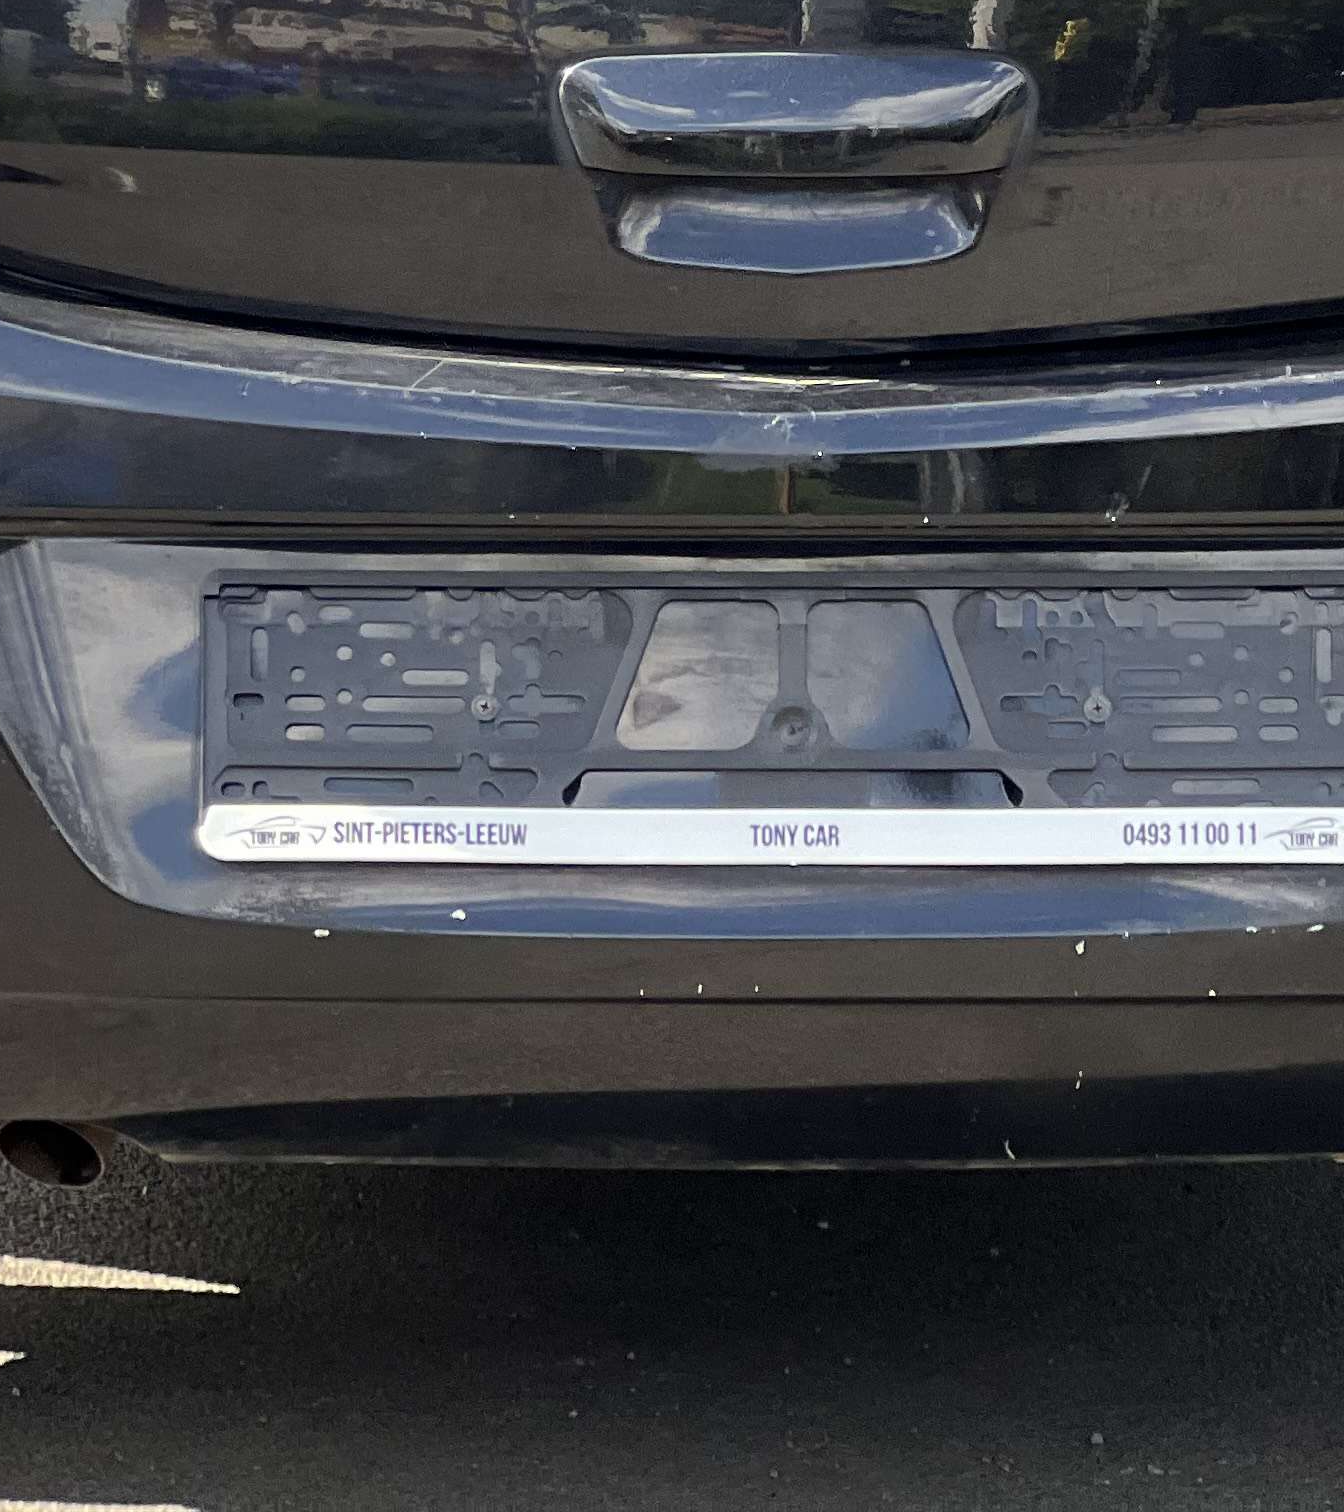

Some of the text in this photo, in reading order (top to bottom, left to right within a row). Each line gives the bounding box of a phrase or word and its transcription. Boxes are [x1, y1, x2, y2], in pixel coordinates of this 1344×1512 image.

[333, 821, 528, 846] SINT-PIETERS-LEEUW
[749, 823, 840, 847] TONY CAR
[1122, 822, 1257, 846] 0493 11 00 11
